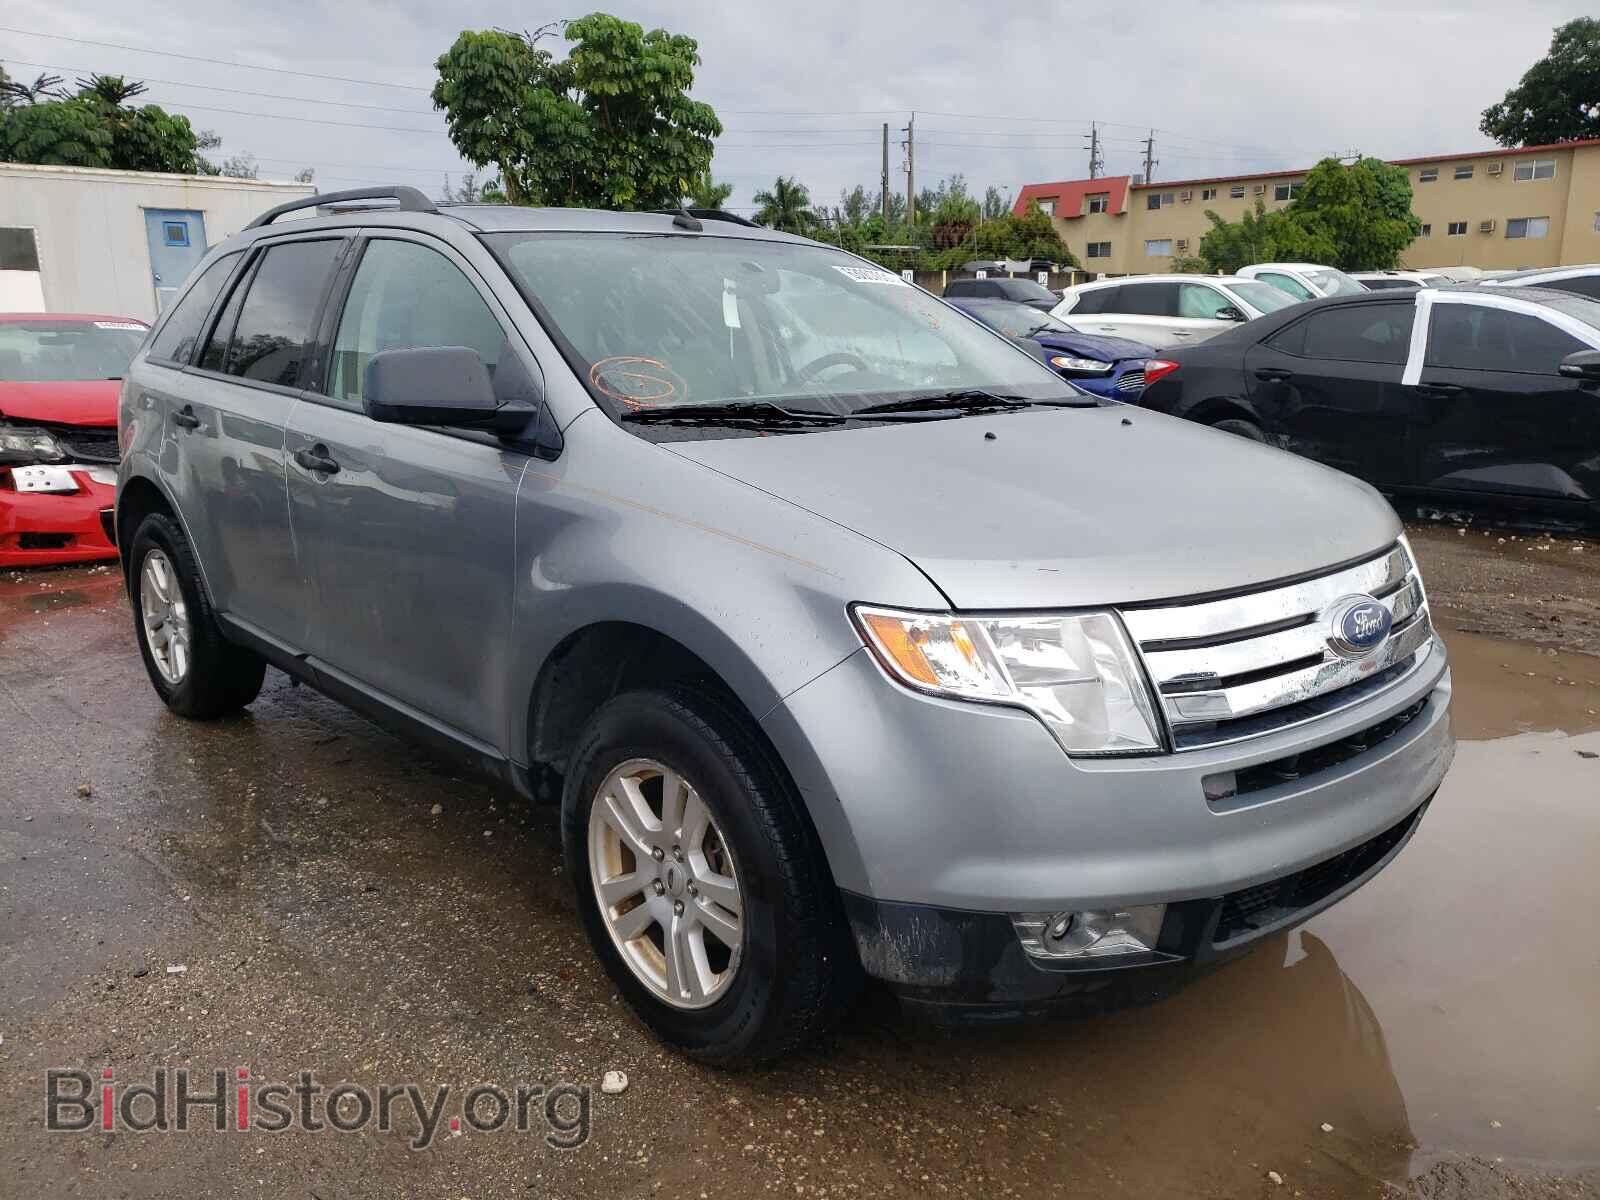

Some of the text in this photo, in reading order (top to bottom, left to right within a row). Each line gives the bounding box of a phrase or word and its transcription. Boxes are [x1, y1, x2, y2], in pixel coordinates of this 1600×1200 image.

[903, 272, 912, 281] 10
[1039, 273, 1047, 284] 12
[1353, 607, 1384, 637] Ford
